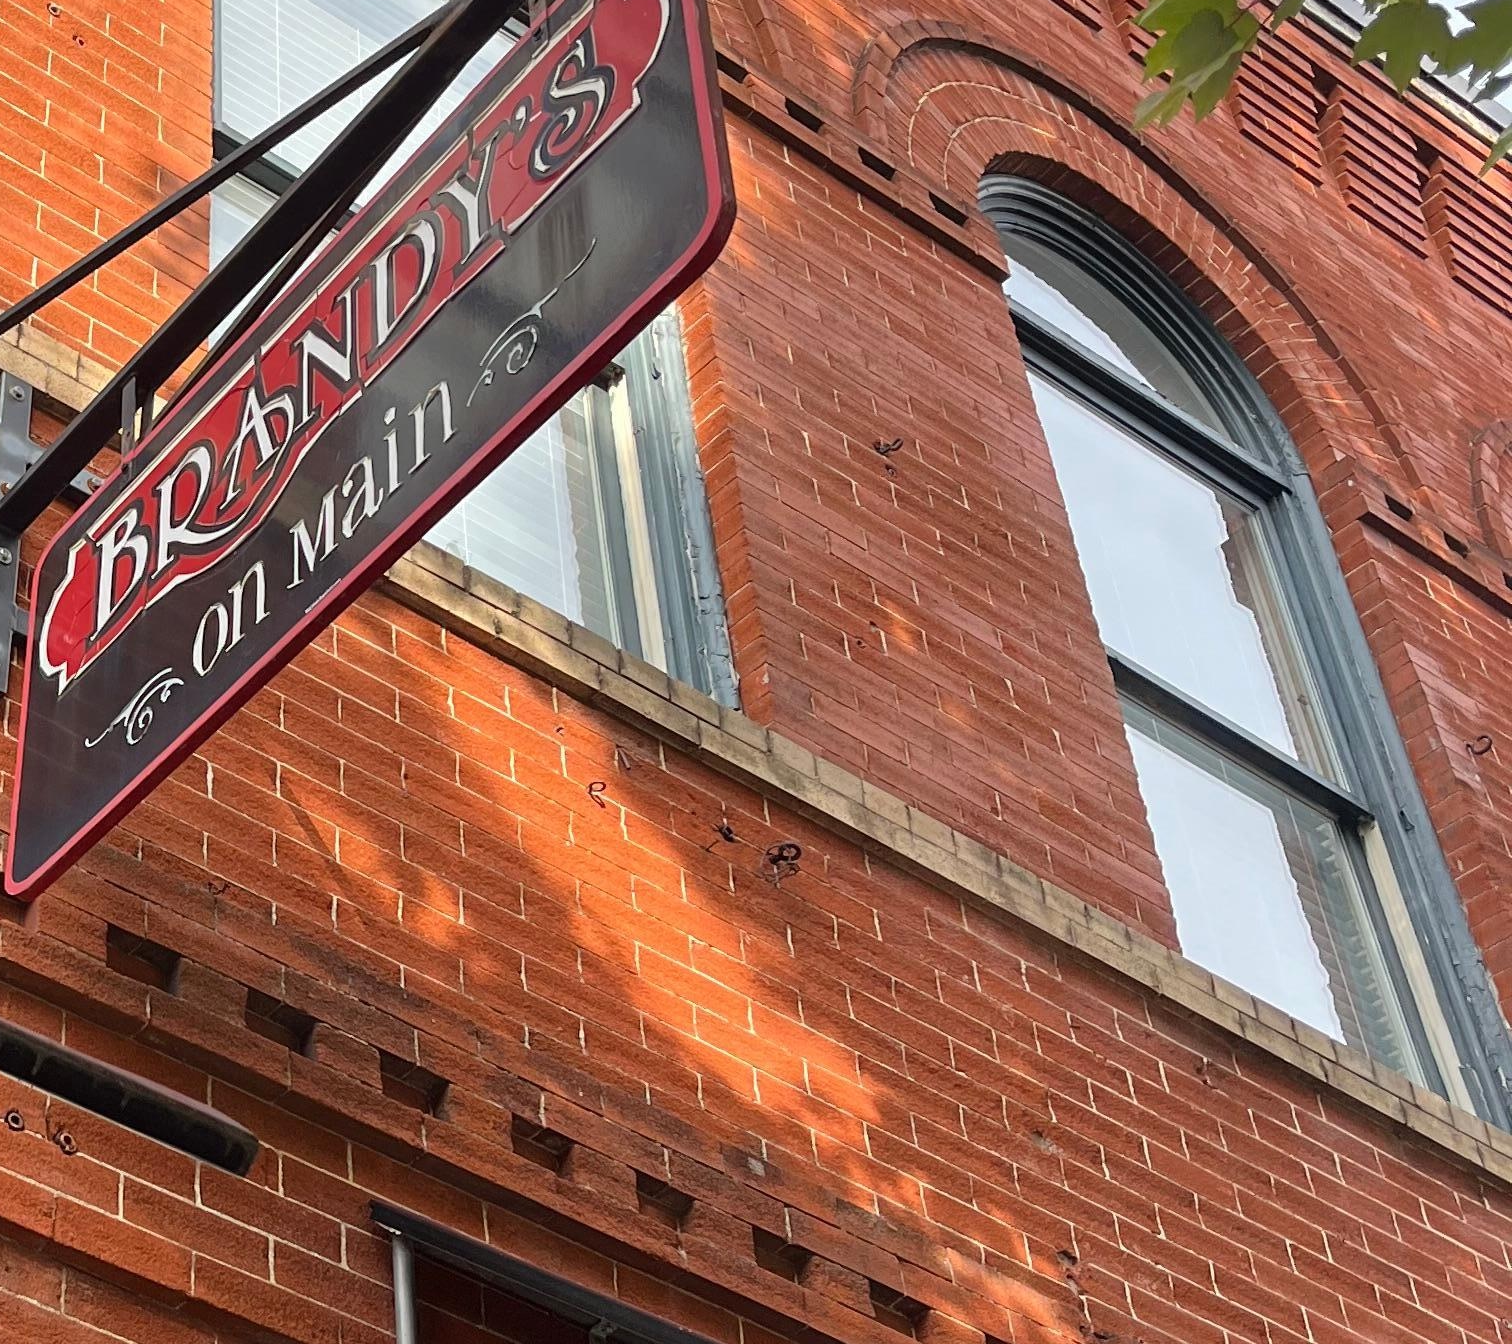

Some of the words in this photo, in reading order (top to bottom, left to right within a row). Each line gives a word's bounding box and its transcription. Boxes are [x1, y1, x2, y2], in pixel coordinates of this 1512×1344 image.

[90, 37, 610, 642] BRANDY'S
[192, 560, 270, 677] on
[287, 381, 459, 590] Main
